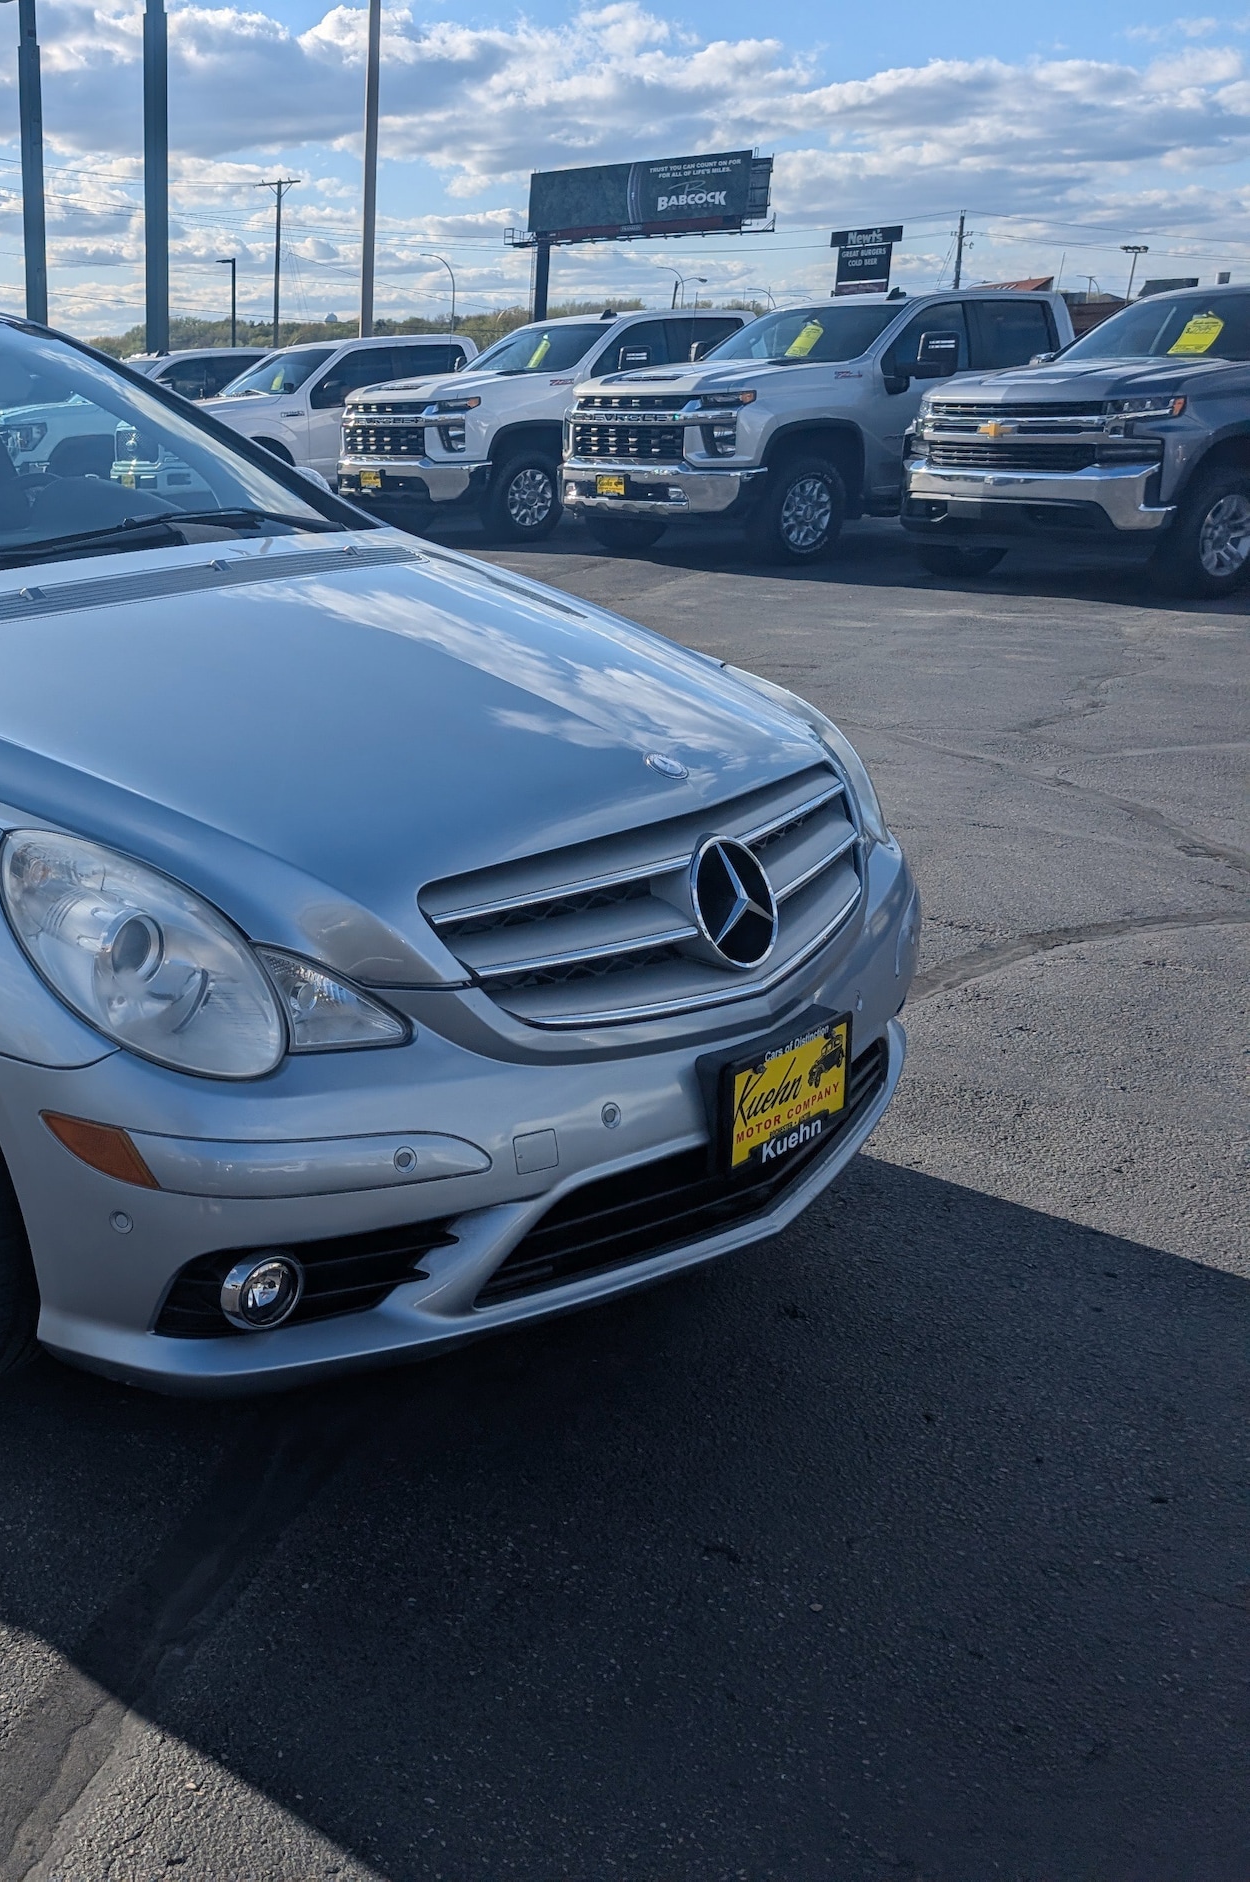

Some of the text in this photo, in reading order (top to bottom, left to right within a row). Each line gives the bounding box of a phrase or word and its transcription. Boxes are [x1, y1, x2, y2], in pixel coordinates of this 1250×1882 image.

[657, 190, 727, 212] BABCOCK
[847, 228, 883, 245] Newt's
[841, 247, 886, 258] GREAT BURGERS
[848, 258, 878, 267] COLD BEER
[764, 1024, 830, 1062] Cars of Distinction
[734, 1057, 803, 1127] Kuehn
[736, 1082, 840, 1145] MOTOR COMPANY
[761, 1119, 822, 1164] Kuehn
